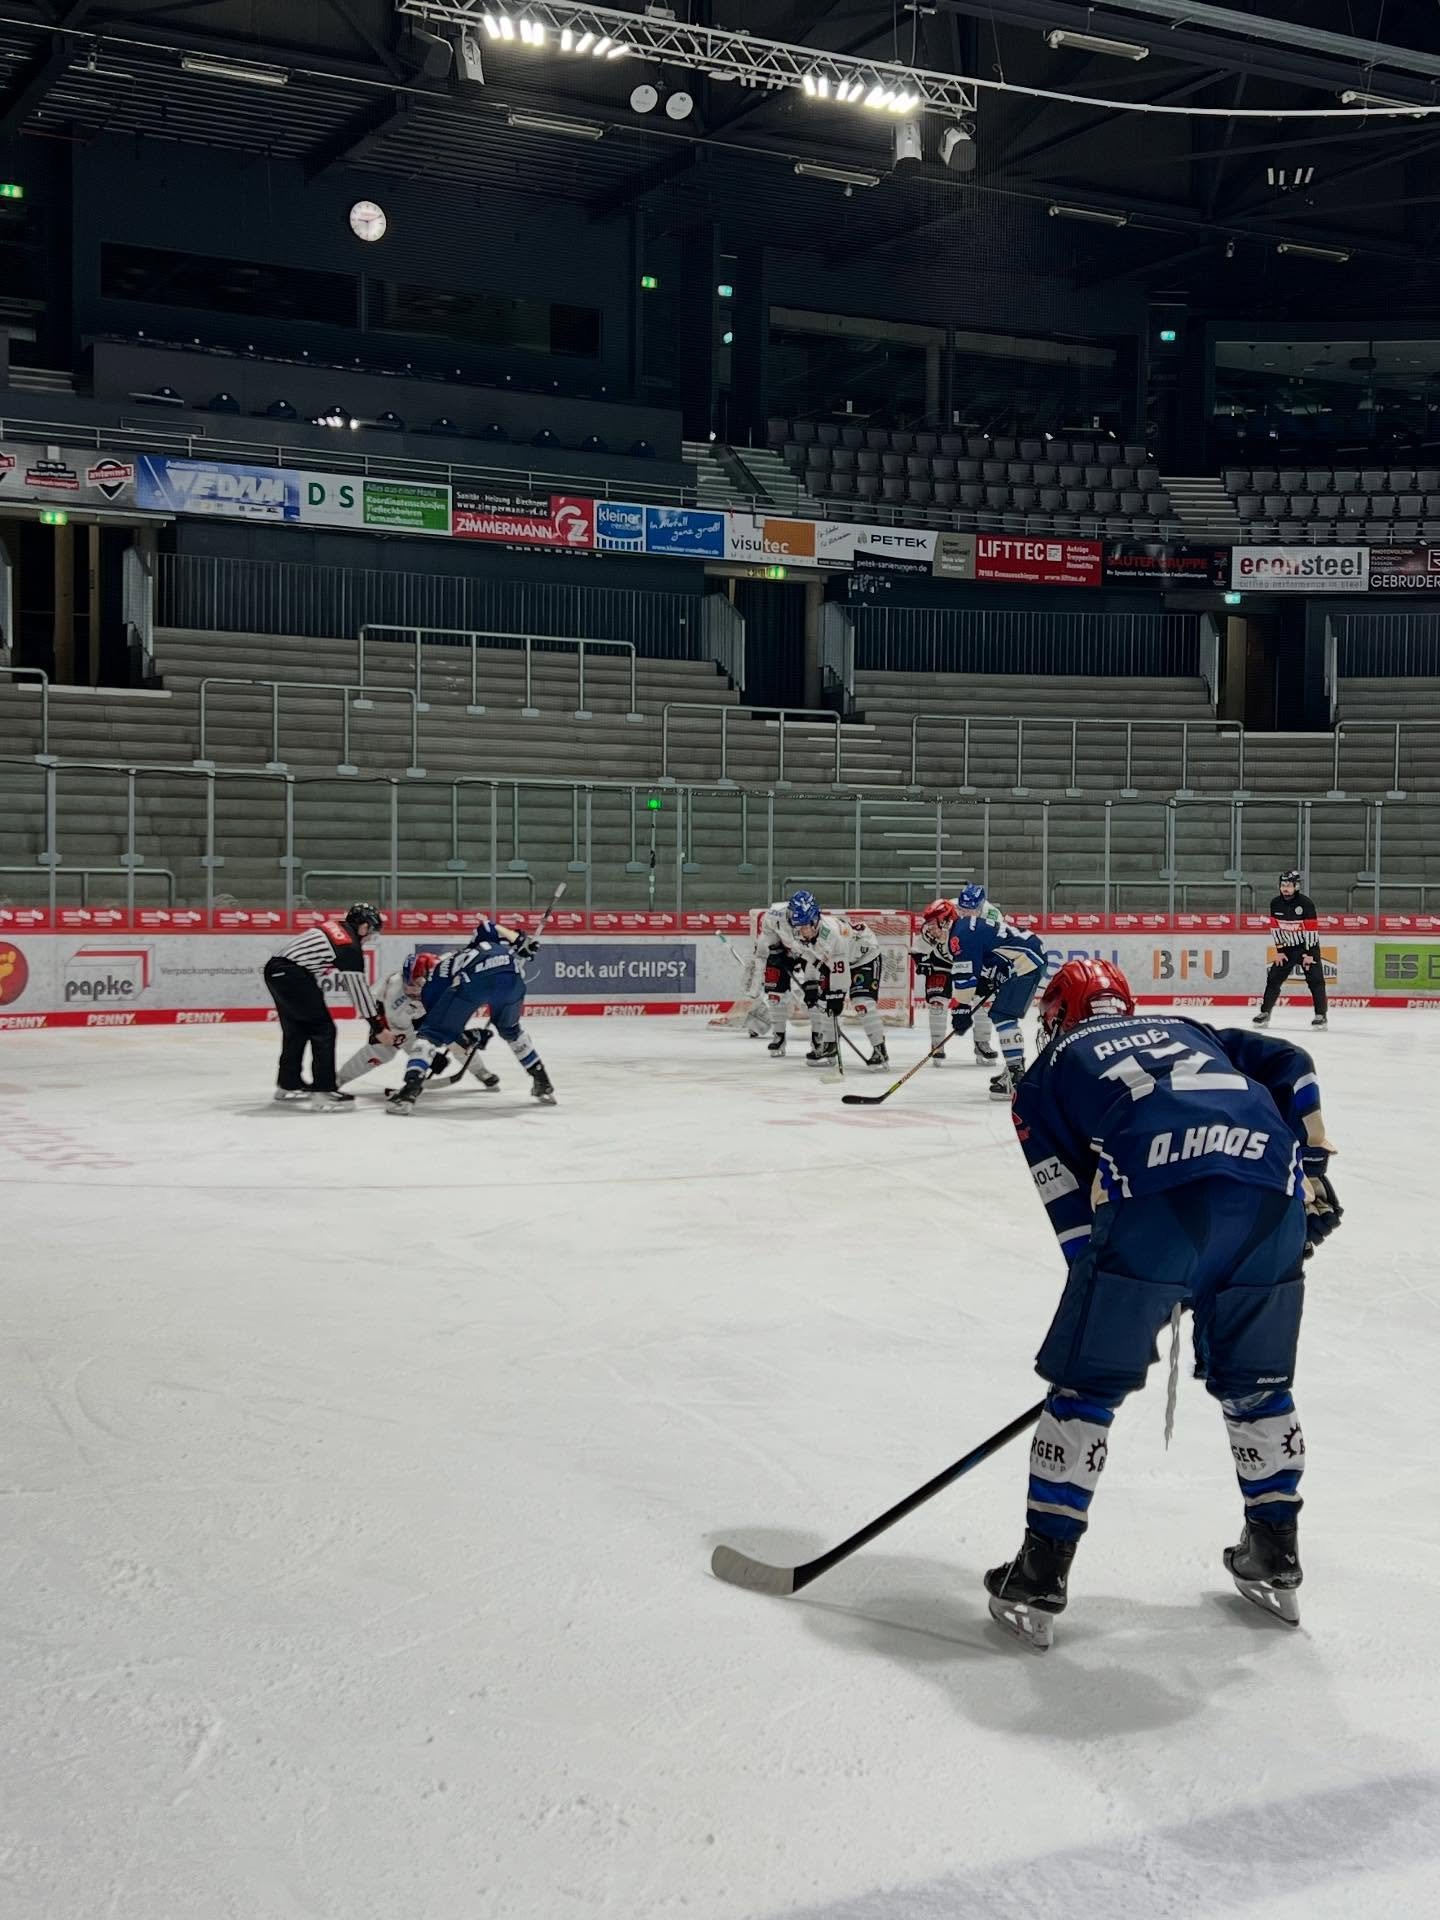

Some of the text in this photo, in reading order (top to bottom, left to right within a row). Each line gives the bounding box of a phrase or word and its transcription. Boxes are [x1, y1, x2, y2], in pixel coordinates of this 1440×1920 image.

[308, 482, 354, 508] D S
[598, 508, 641, 524] kleiner
[456, 518, 553, 539] ZIMMERMANN
[731, 535, 790, 554] visutec
[870, 534, 928, 549] PETEK
[978, 539, 1045, 561] LIFTTEC
[554, 961, 687, 978] Bock auf CHIPS?
[1152, 949, 1230, 980] BFU
[65, 974, 133, 1001] papke
[1098, 1041, 1249, 1102] 12
